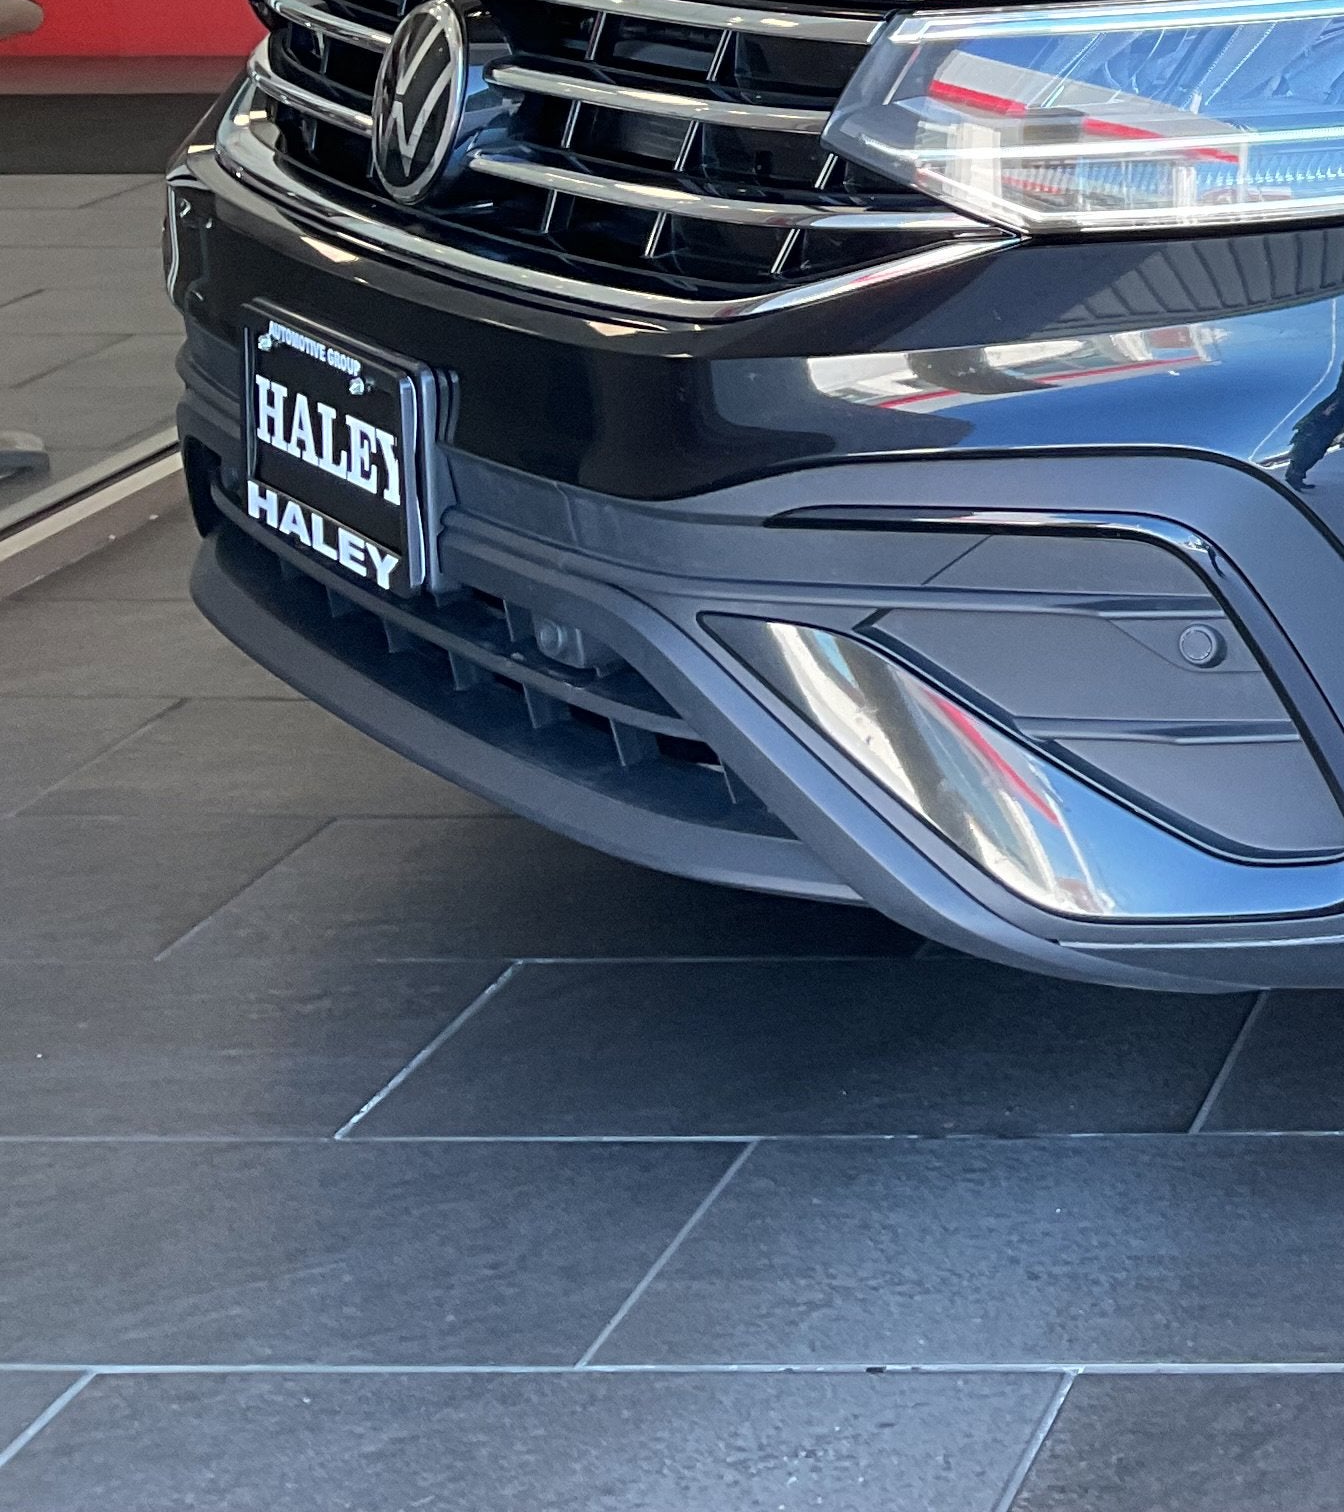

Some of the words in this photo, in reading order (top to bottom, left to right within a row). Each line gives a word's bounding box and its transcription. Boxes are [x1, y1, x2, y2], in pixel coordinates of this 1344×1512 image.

[268, 320, 327, 363] AUTOMOTIVE
[326, 346, 362, 377] GROUP
[255, 373, 401, 506] HALEY
[248, 479, 400, 591] HALEY
